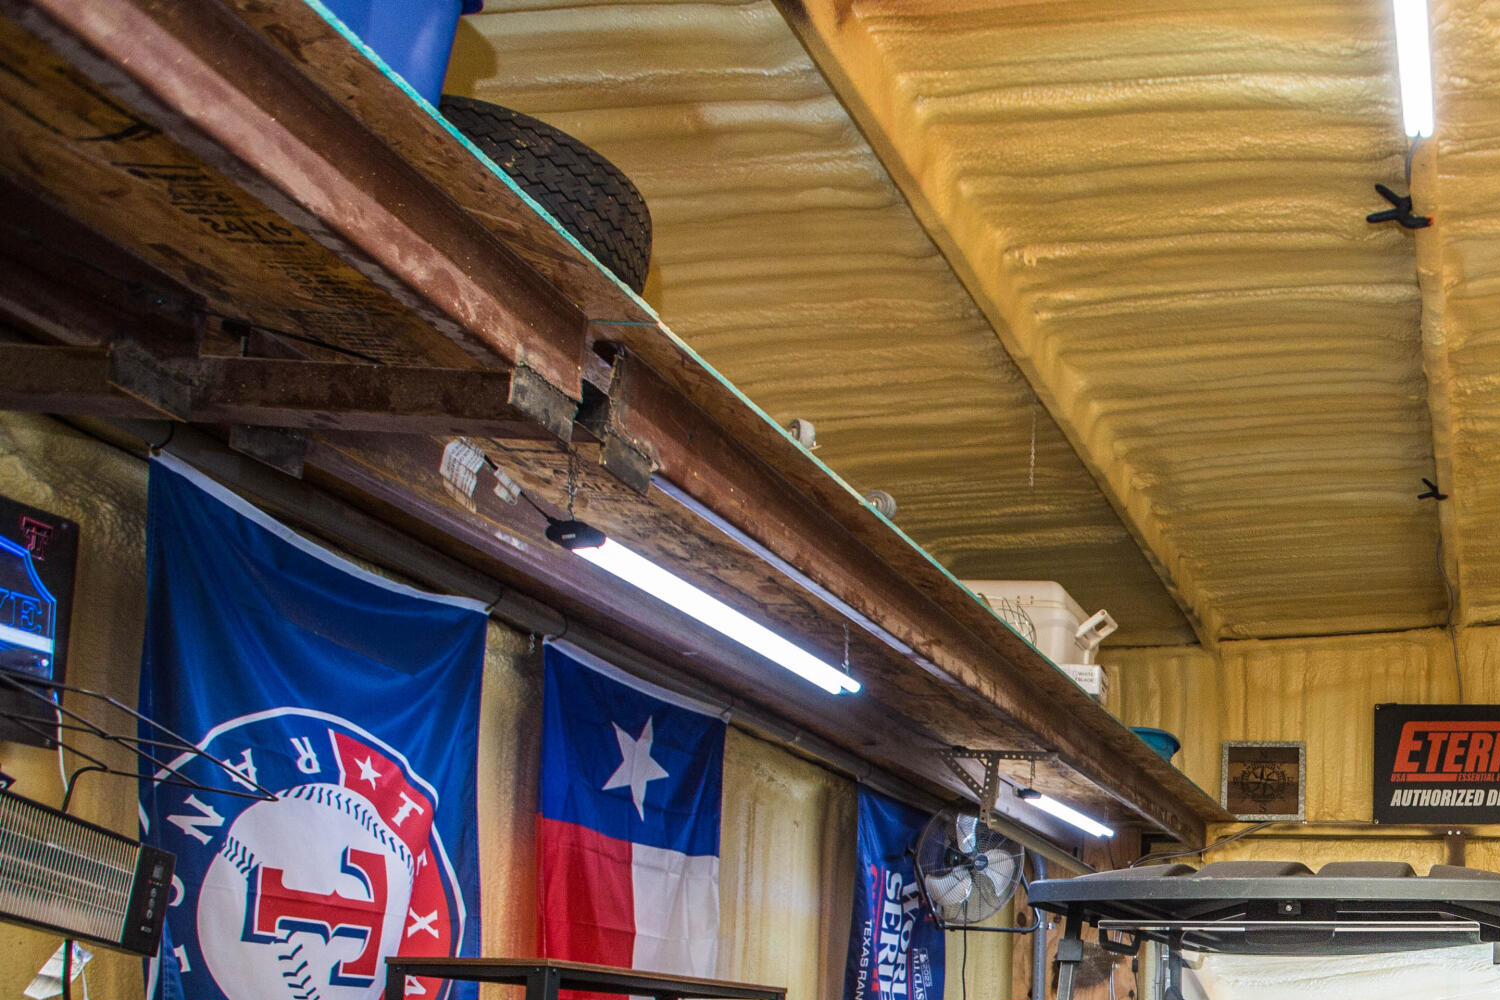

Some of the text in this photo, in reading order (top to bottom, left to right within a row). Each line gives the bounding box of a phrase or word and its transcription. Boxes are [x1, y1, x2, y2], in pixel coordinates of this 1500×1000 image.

[1458, 773, 1495, 782] ESSENTIAL
[1390, 789, 1485, 807] AUTHORIZED
[860, 919, 873, 968] TEXAS
